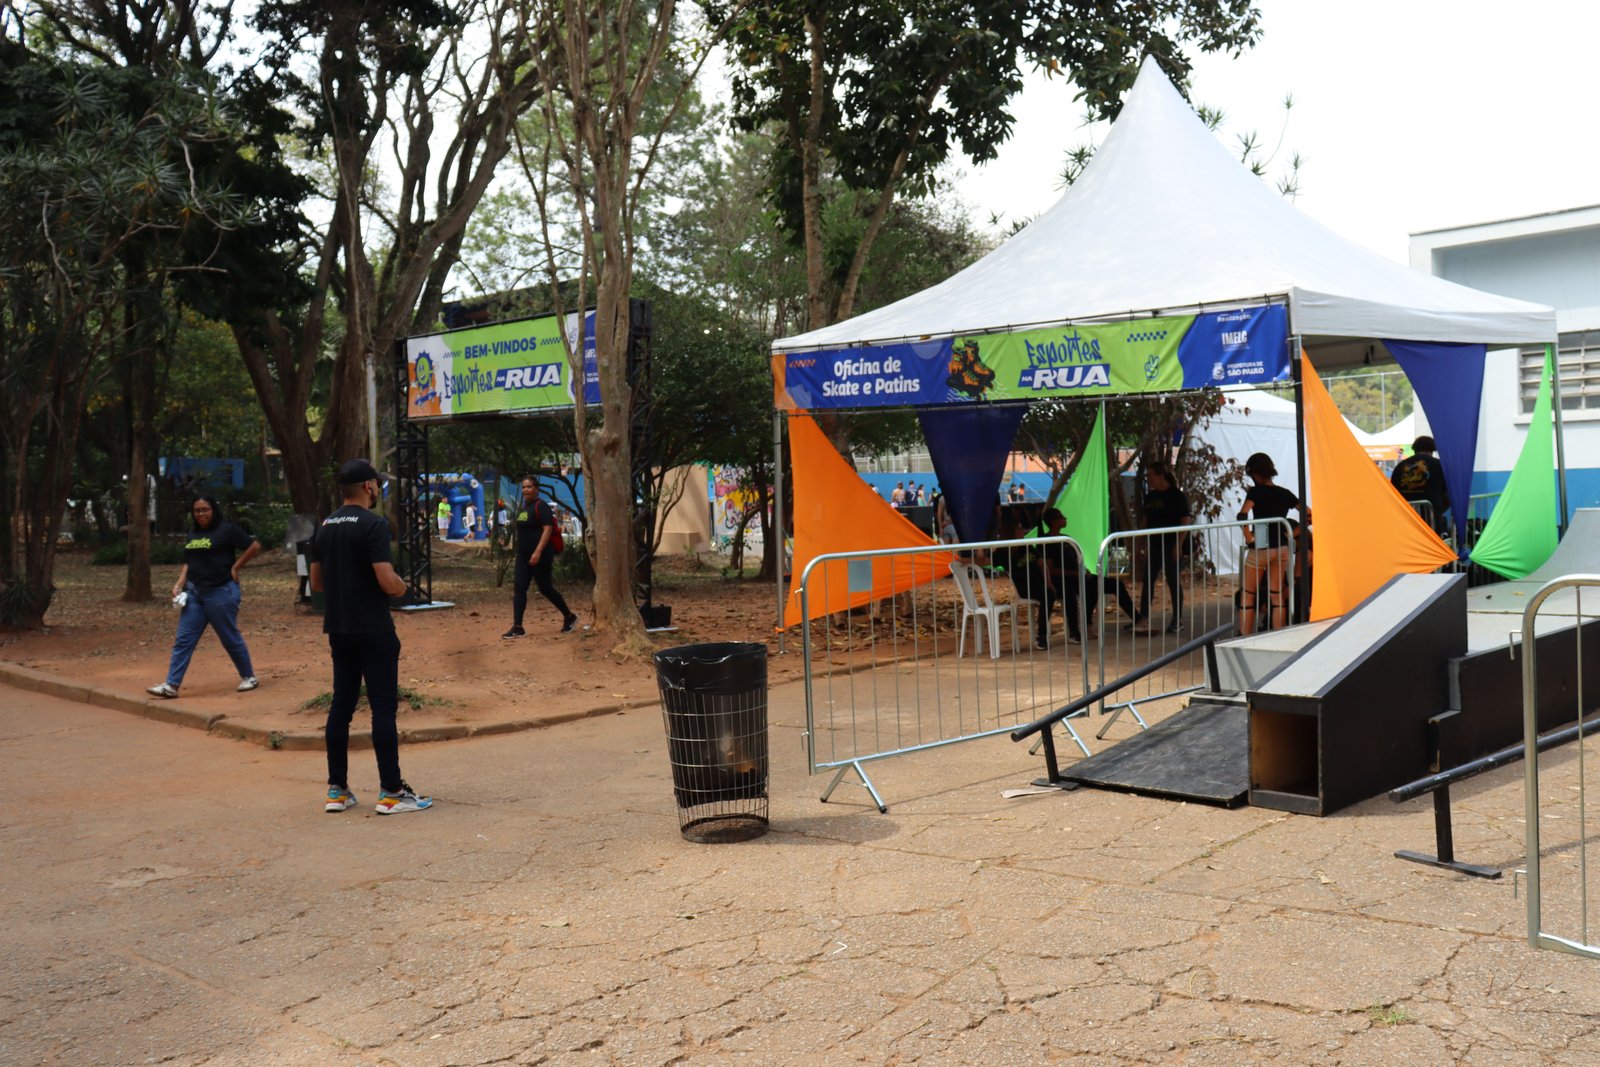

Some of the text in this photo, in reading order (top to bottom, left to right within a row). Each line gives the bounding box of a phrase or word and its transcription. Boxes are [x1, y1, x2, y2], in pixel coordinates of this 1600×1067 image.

[464, 337, 537, 360] BEM-VINDOS
[1024, 330, 1102, 377] Esportes
[833, 356, 901, 380] Oficina de
[1032, 364, 1110, 389] RUA
[1242, 367, 1265, 376] PAULO
[443, 362, 494, 407] Esportes
[504, 364, 561, 389] RUA
[822, 375, 920, 397] Skate e Patins
